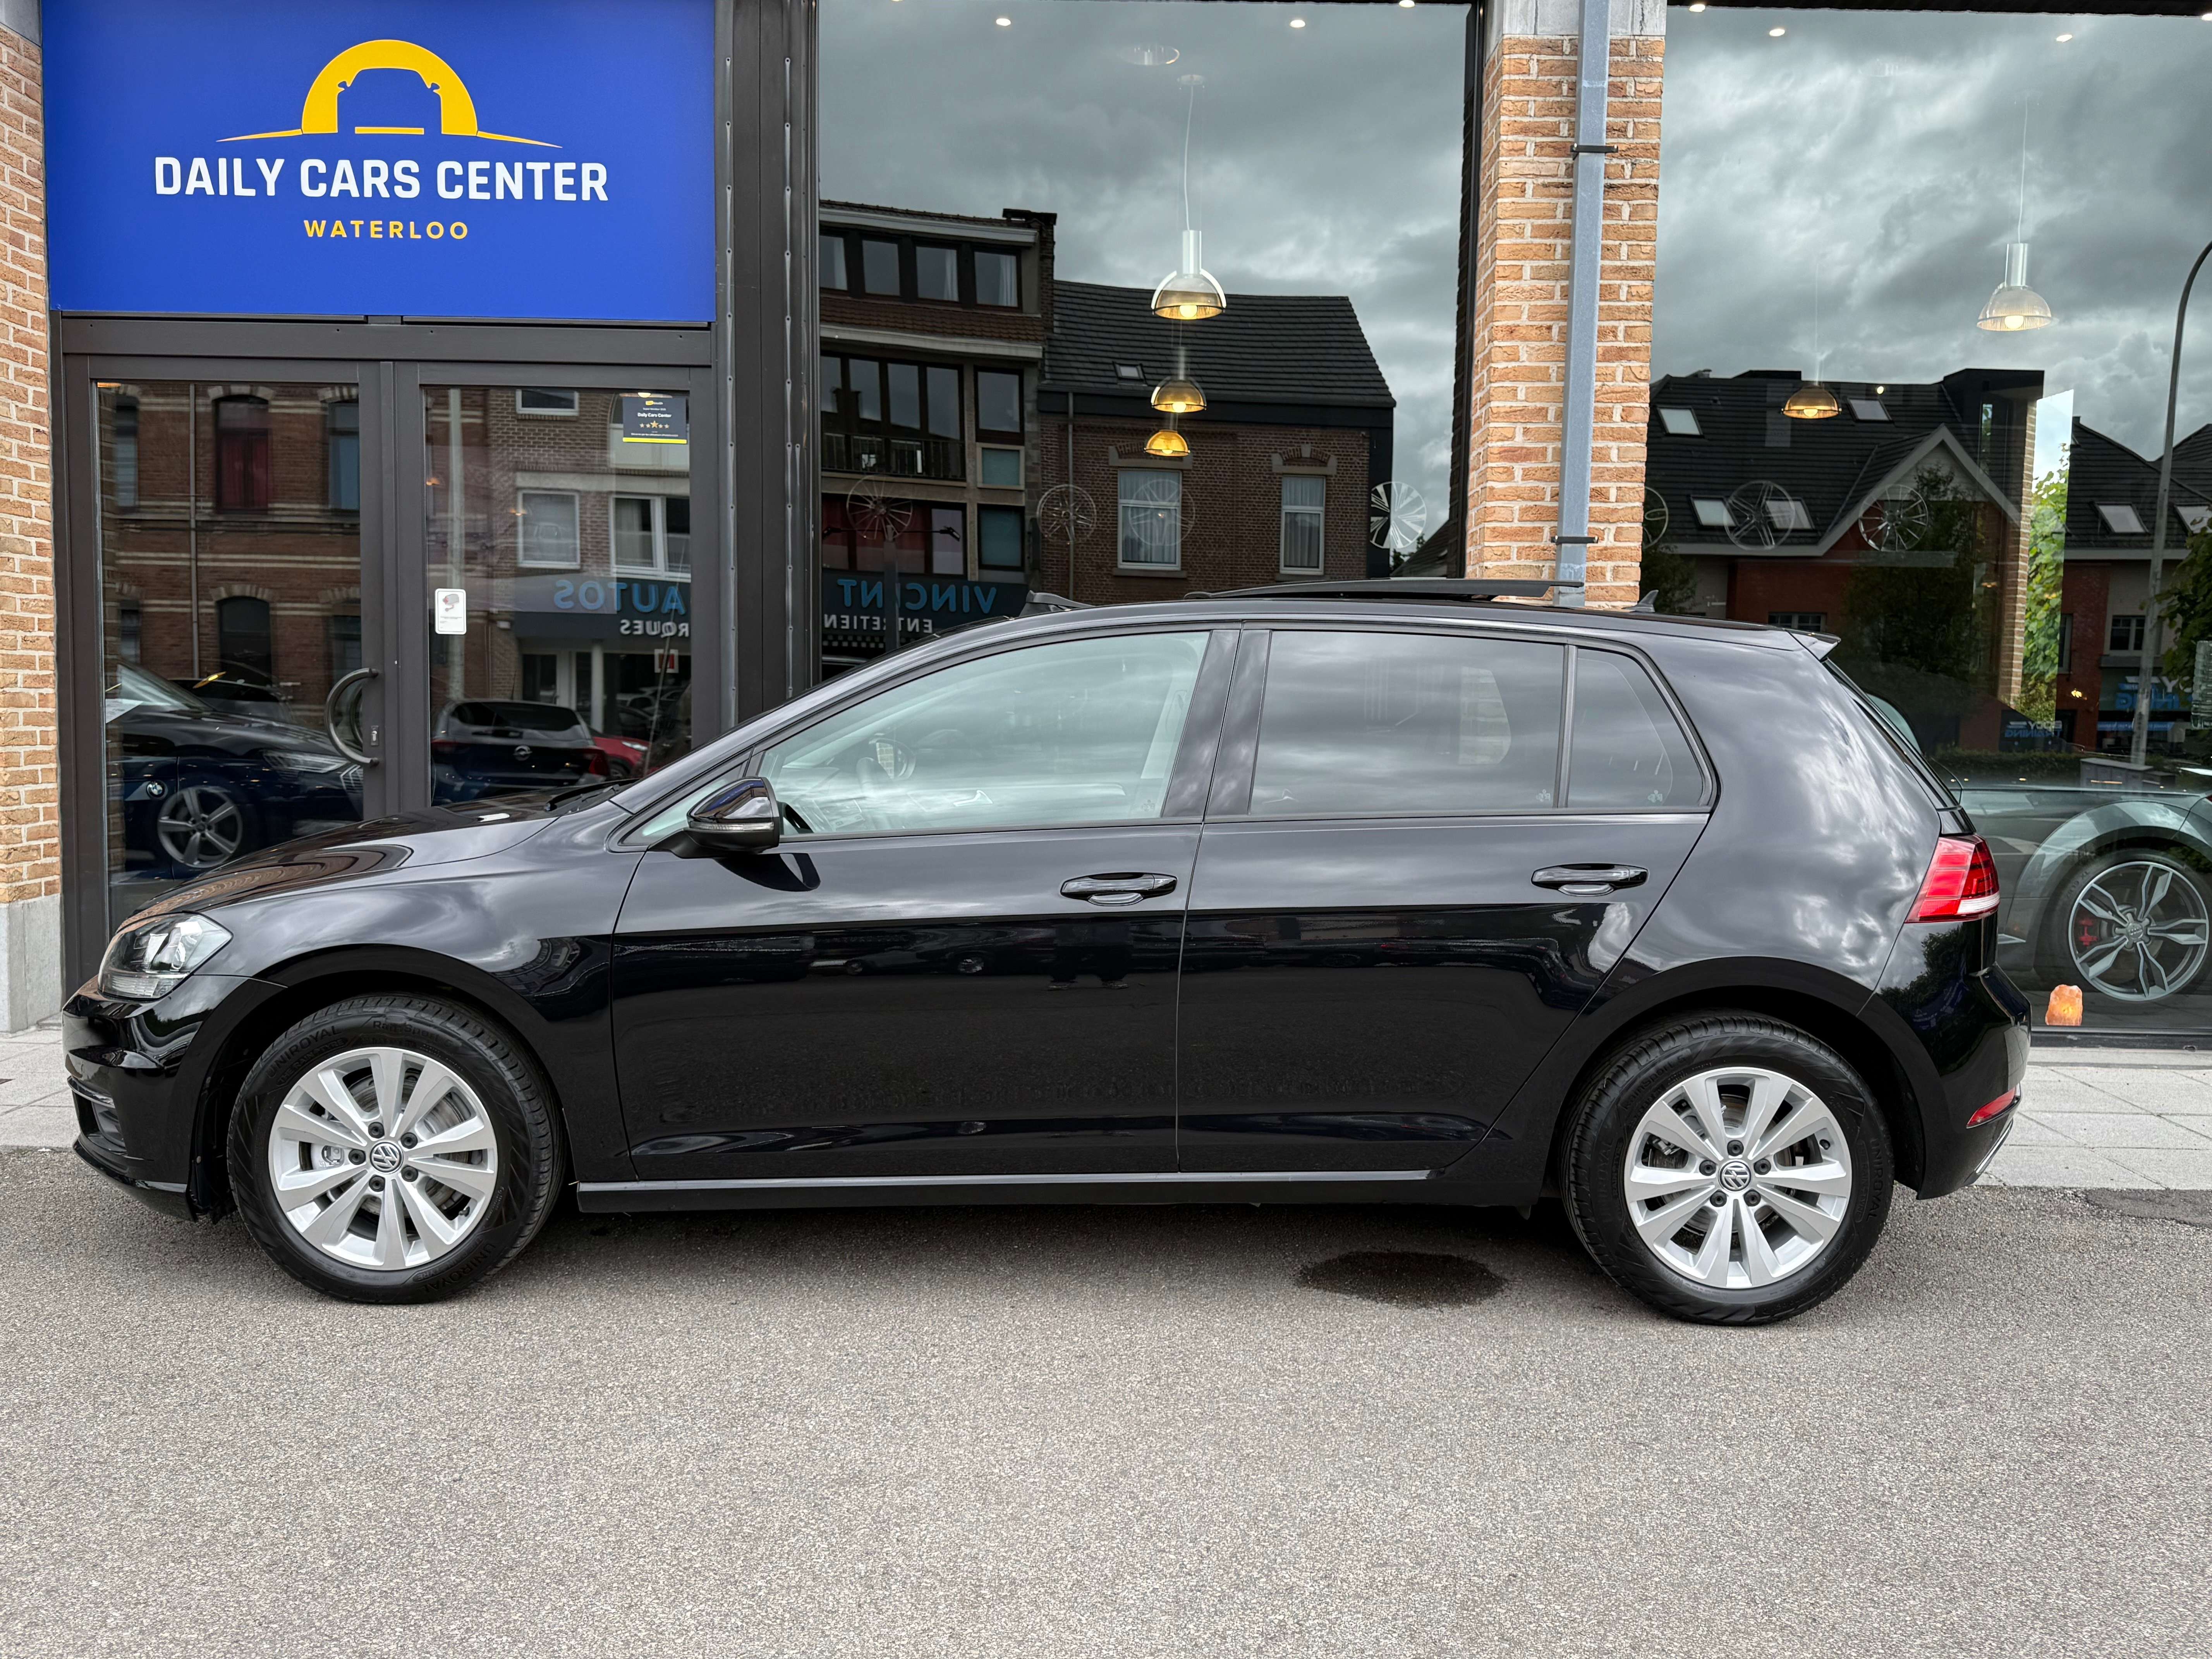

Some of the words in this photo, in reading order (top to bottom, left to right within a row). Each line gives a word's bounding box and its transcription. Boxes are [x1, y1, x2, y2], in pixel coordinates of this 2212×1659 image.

[155, 156, 285, 197] DAILY
[300, 158, 421, 199] CARS
[436, 160, 609, 201] CENTER
[304, 220, 468, 239] WATERLOO
[264, 1022, 340, 1080] UNIROYAL
